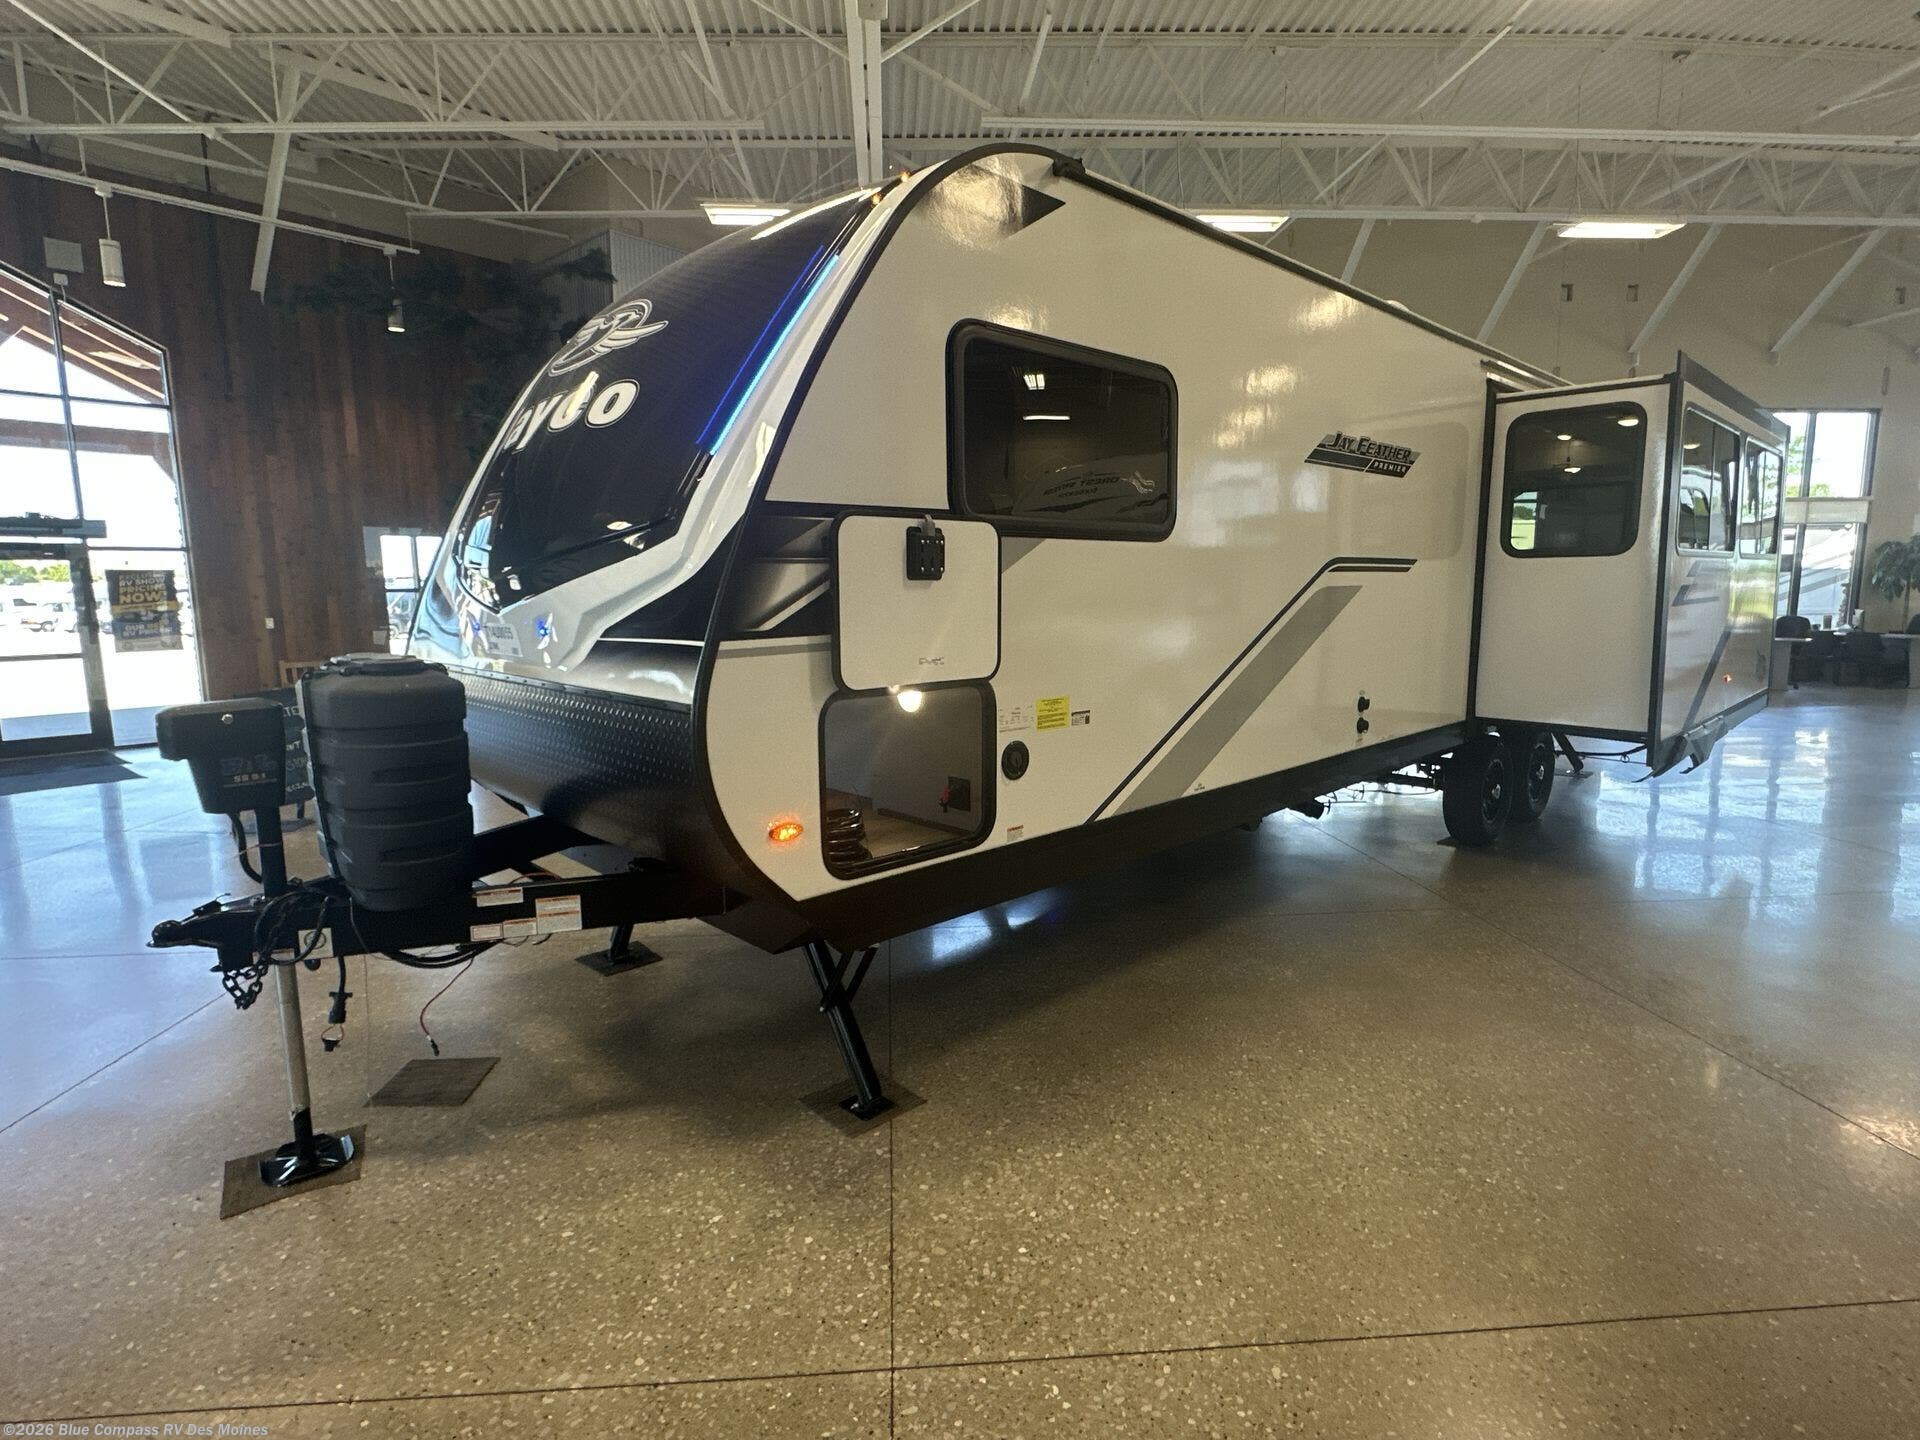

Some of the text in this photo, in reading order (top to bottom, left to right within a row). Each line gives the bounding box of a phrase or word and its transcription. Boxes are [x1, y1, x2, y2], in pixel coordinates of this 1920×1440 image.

[501, 378, 640, 455] ayco
[1325, 431, 1412, 462] JAY FEATHER
[1372, 461, 1408, 474] PREMIER
[135, 576, 166, 586] SHOW
[119, 583, 167, 593] PRICING
